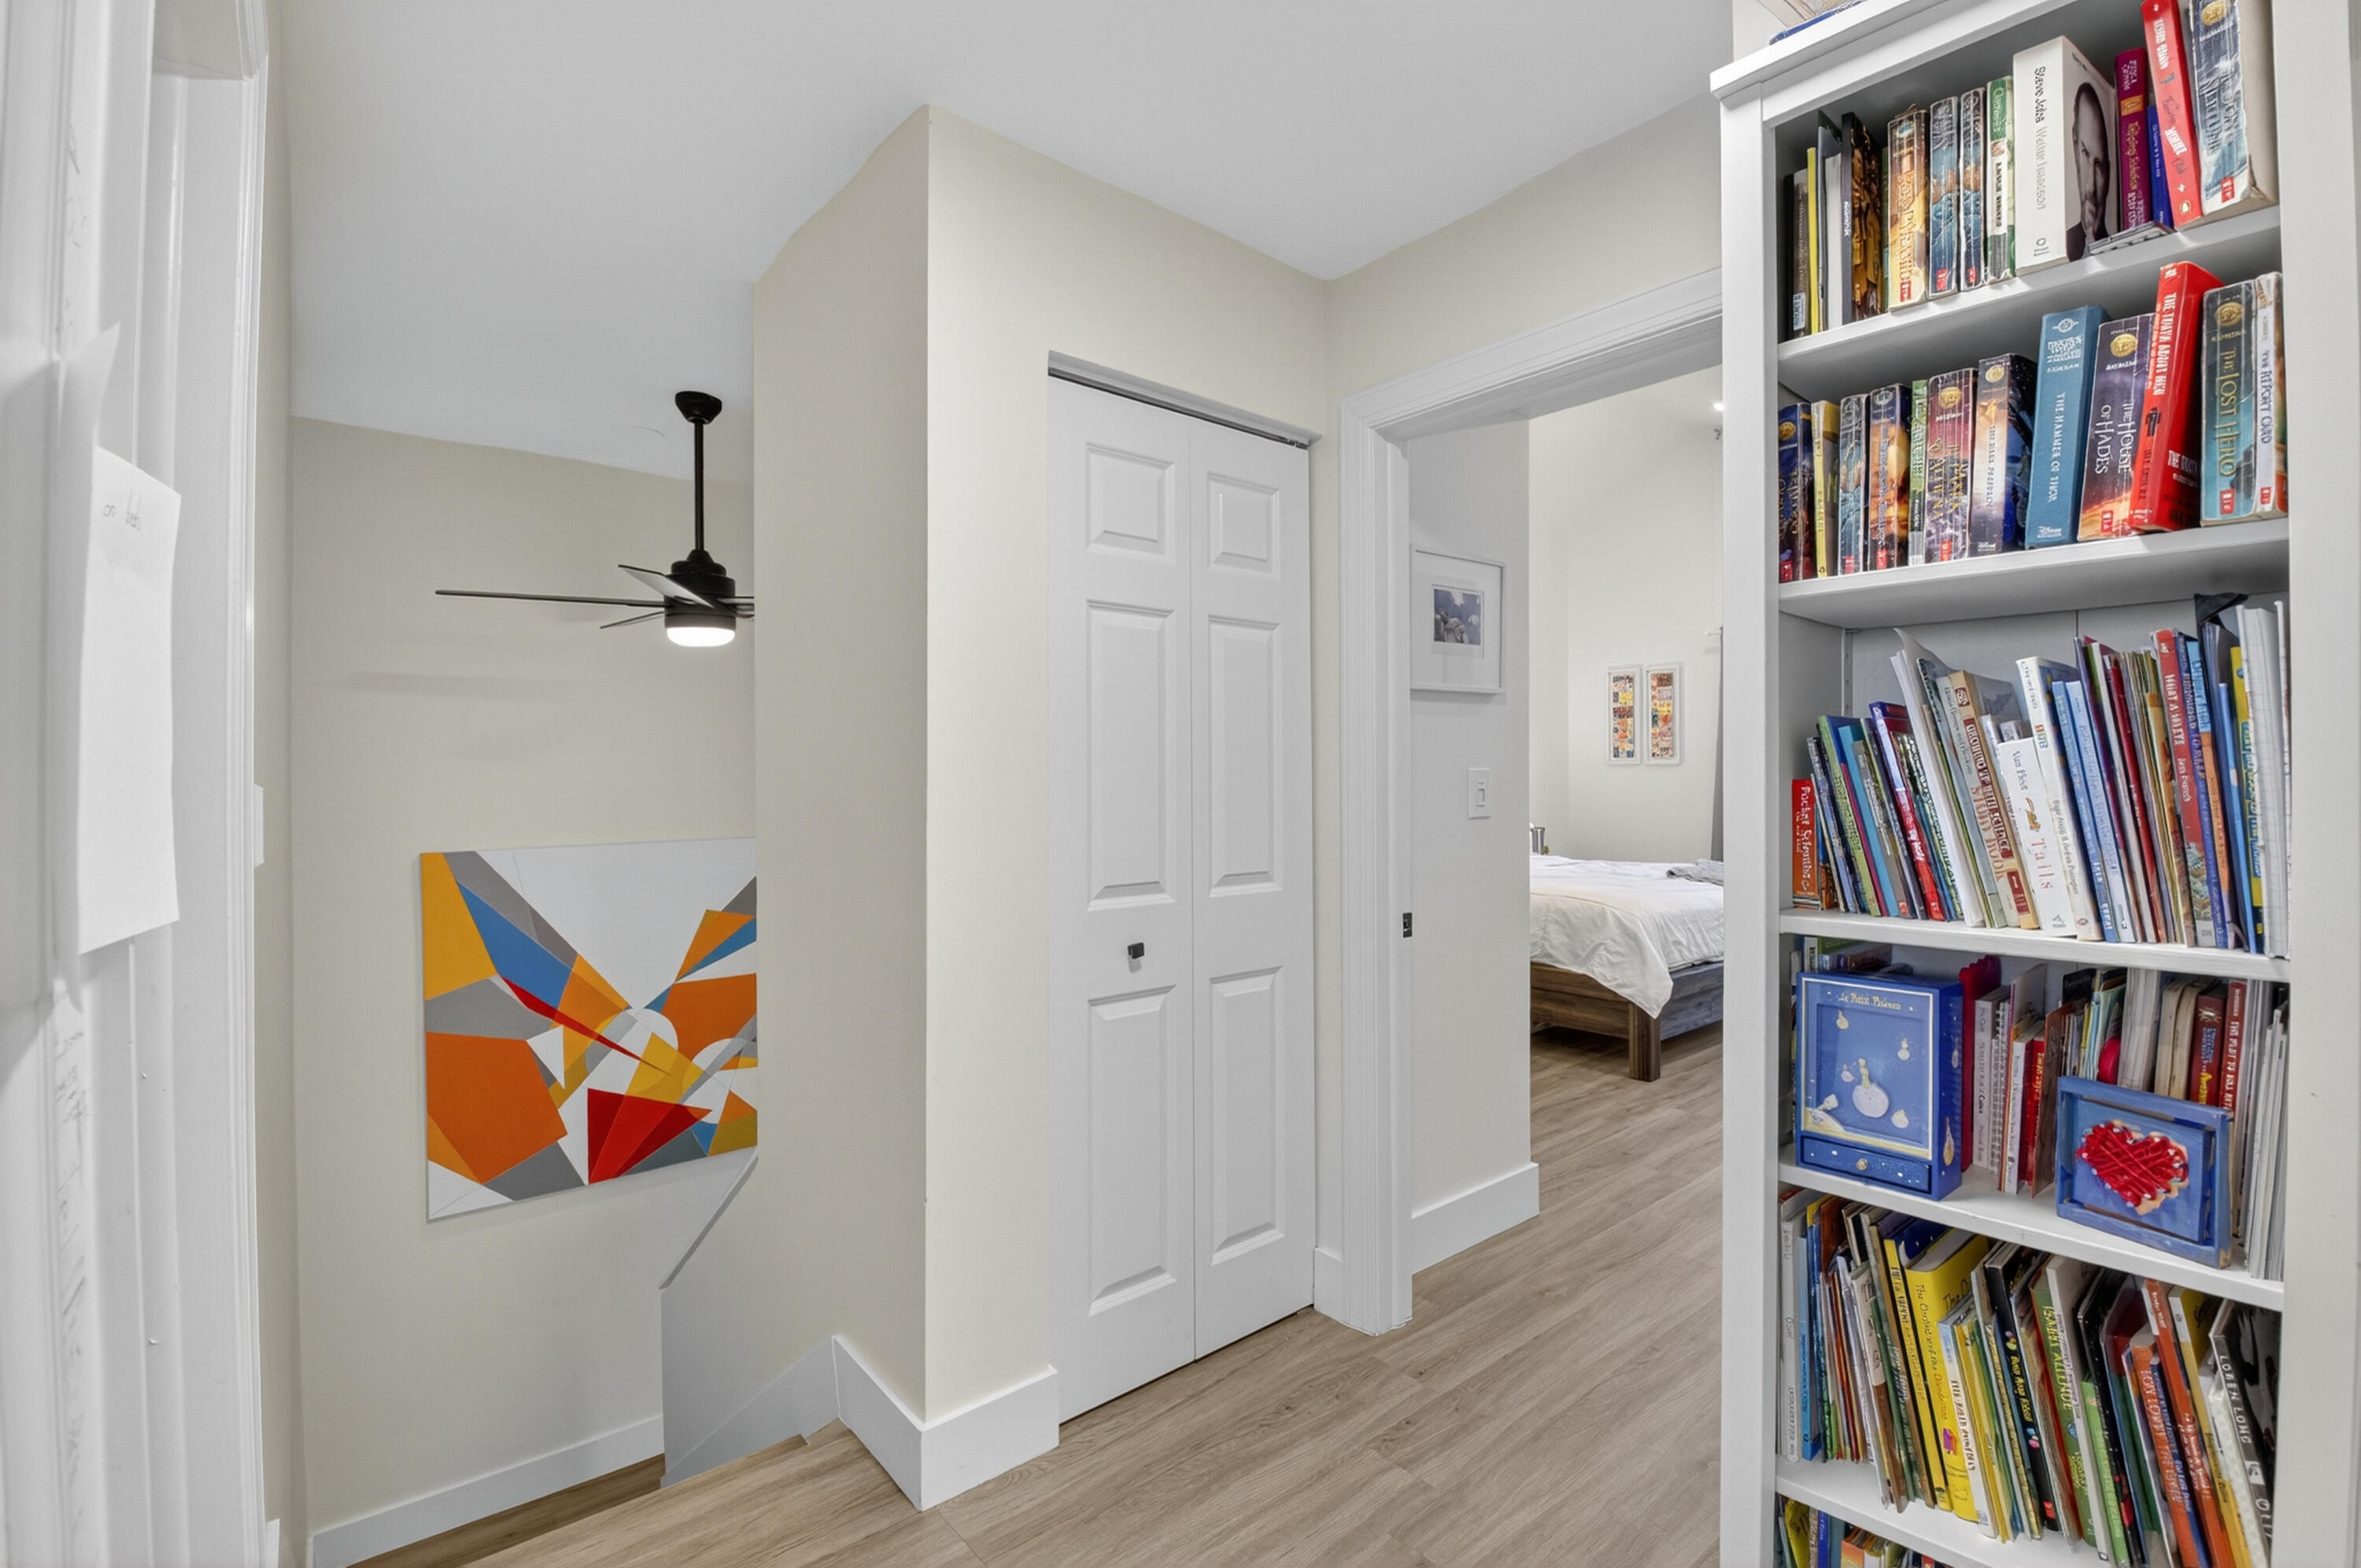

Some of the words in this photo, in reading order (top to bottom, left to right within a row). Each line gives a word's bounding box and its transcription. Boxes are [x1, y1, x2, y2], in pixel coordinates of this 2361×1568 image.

[2219, 372, 2239, 417] LOST
[2094, 419, 2114, 474] HADES
[2215, 422, 2240, 477] HERO
[2219, 1354, 2241, 1401] LOREN
[2234, 1405, 2252, 1445] LONG
